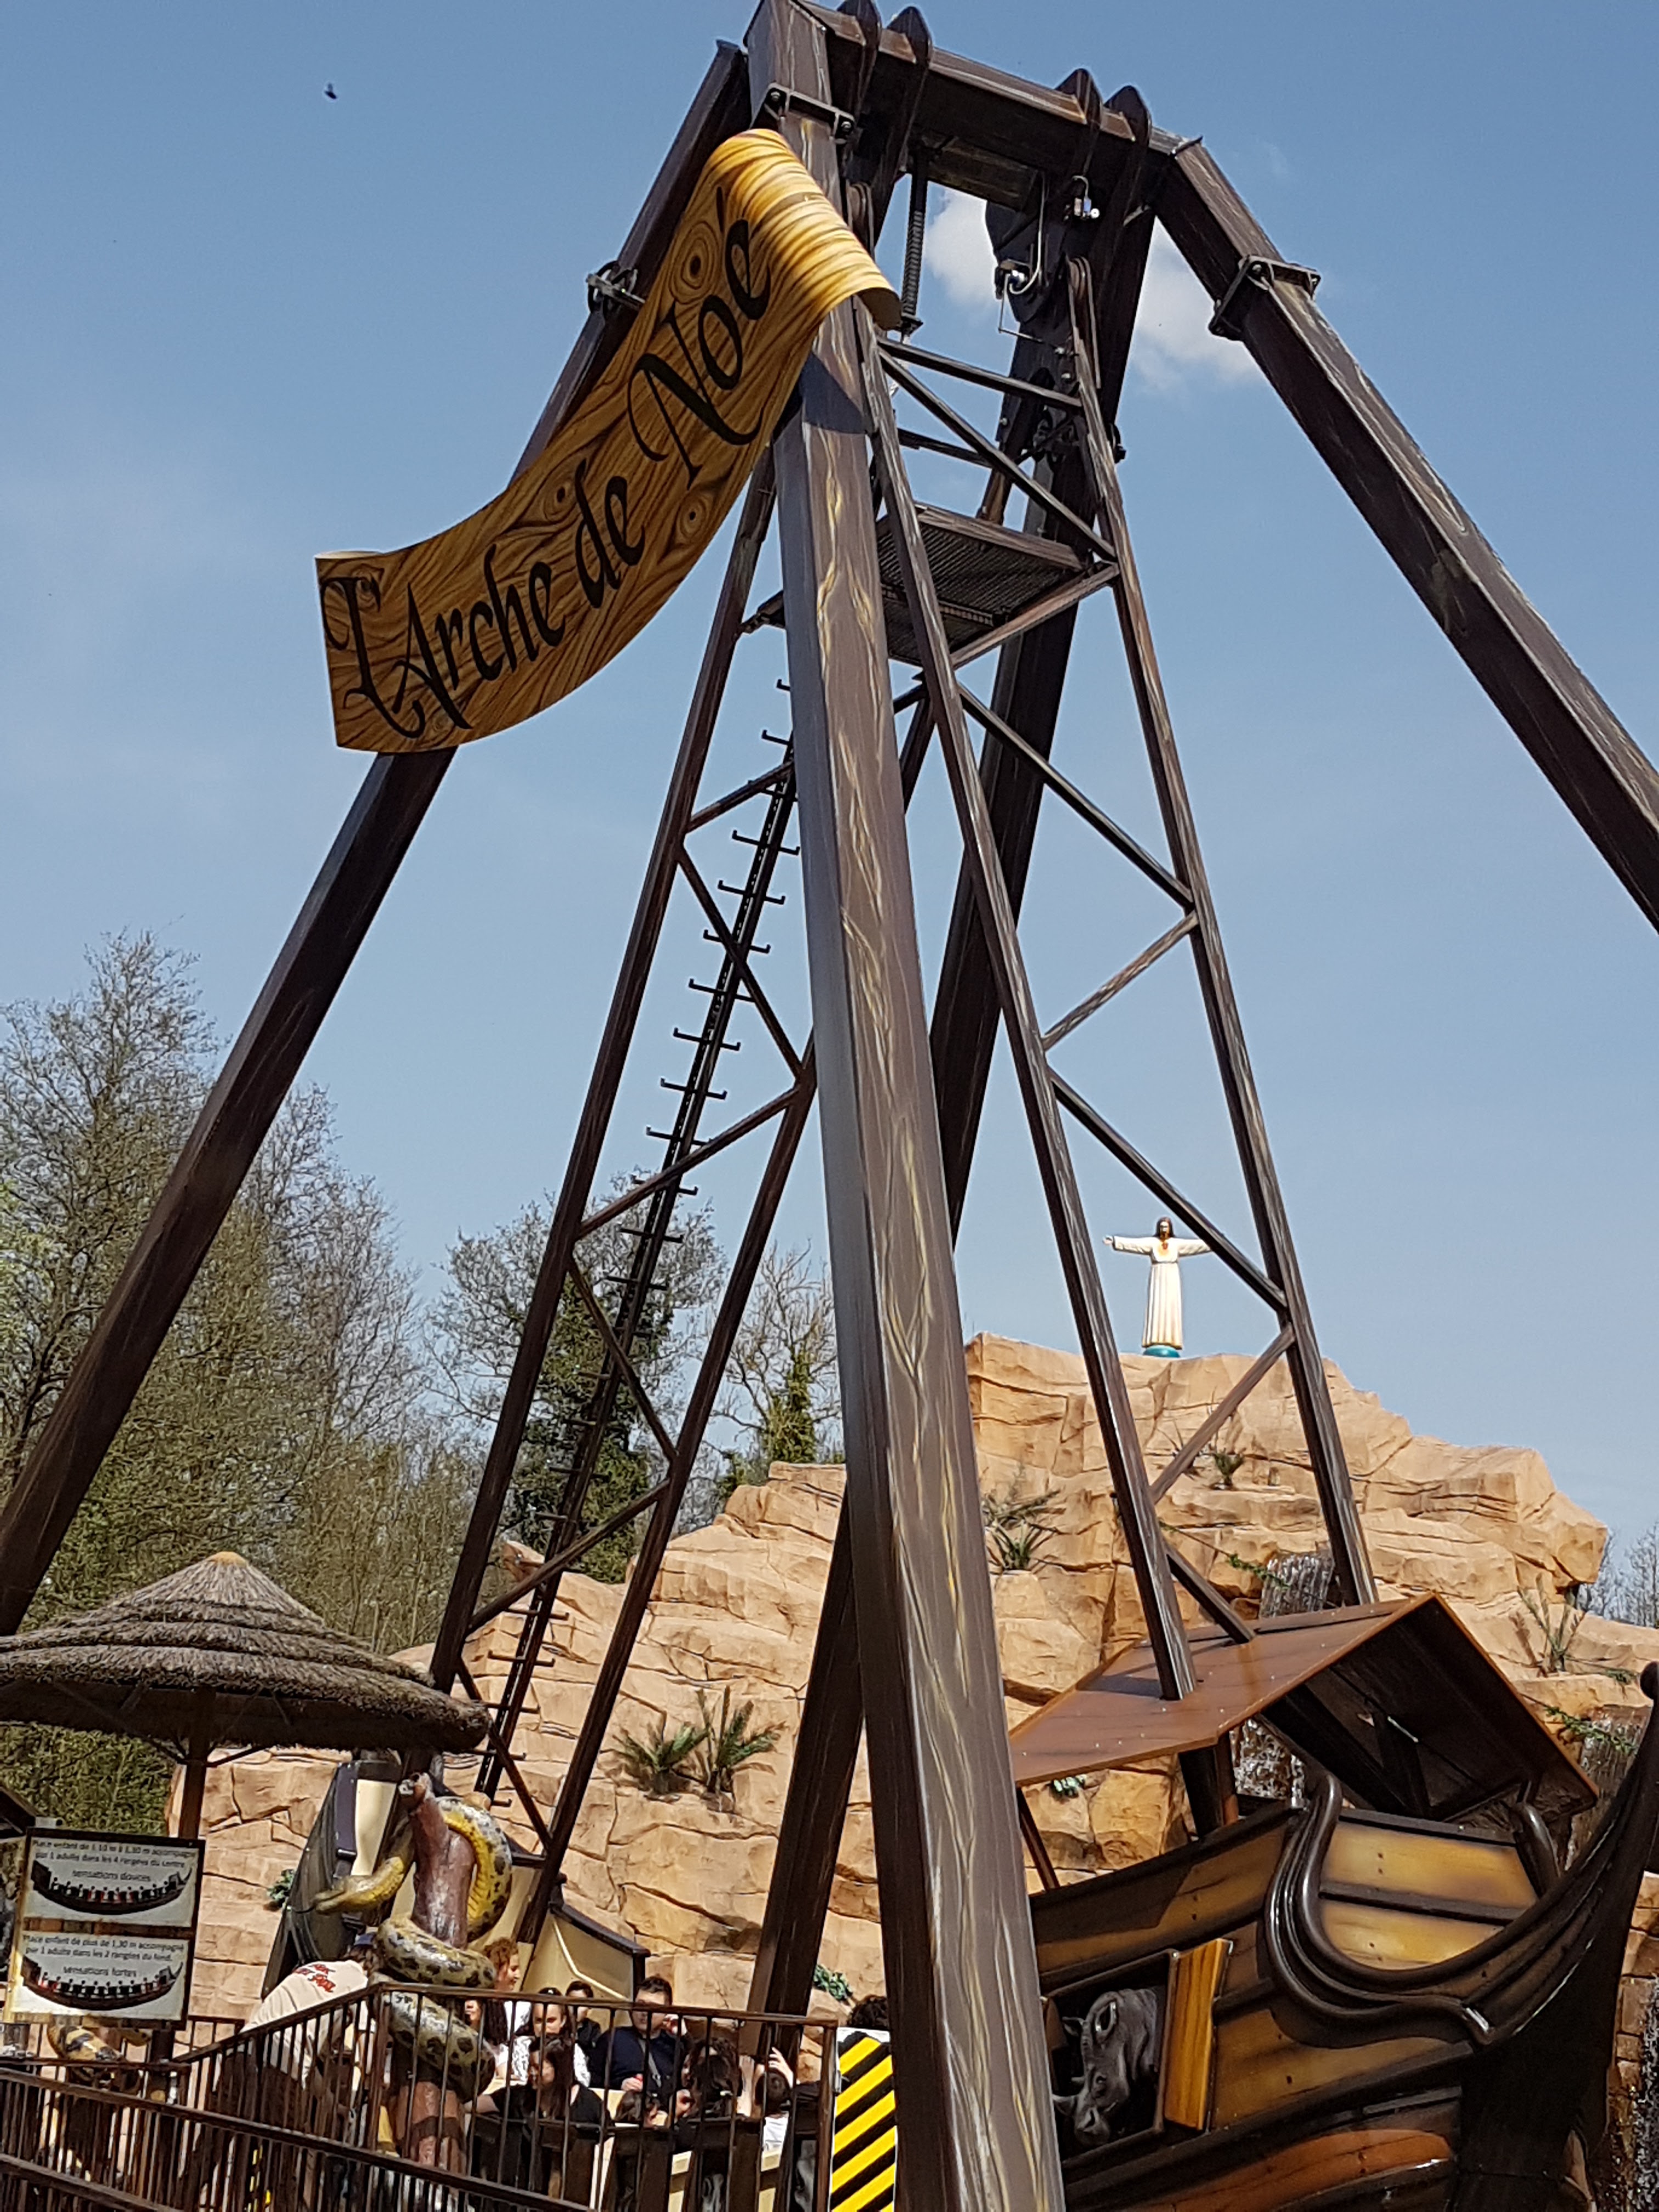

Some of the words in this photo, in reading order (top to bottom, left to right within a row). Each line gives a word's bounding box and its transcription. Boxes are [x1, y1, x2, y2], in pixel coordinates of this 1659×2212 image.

[320, 543, 566, 738] L'Arche
[574, 458, 645, 608] de
[627, 185, 771, 490] Noé
